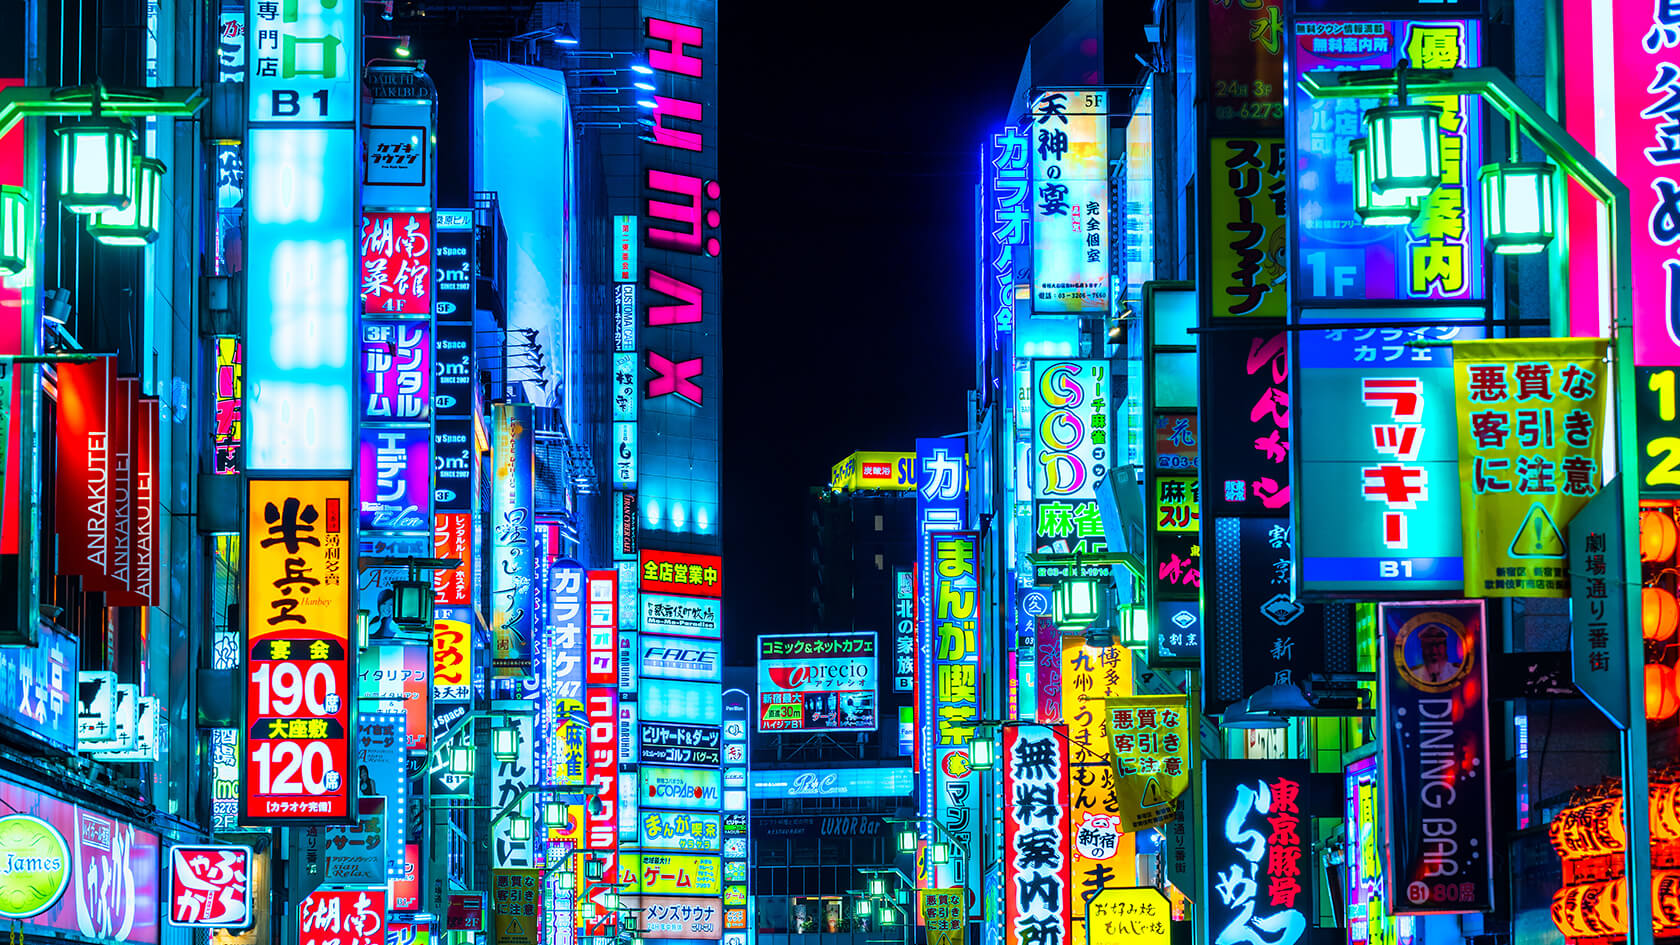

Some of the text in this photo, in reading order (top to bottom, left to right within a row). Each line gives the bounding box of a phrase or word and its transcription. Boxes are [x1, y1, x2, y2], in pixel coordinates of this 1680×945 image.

[271, 89, 329, 117] B1
[1085, 94, 1102, 108] 5F
[371, 154, 421, 165] ラウンジ
[1037, 92, 1071, 217] 天神の宴
[1086, 201, 1101, 264] 完全個室
[1306, 251, 1357, 297] 1F
[382, 297, 407, 313] 4F
[367, 326, 391, 342] 3F
[1354, 345, 1433, 362] カフェ
[367, 348, 393, 417] ルーム
[397, 324, 423, 418] レンタル
[1467, 363, 1596, 403] 悪質な
[1090, 366, 1107, 446] リーチ麻雀
[1038, 361, 1087, 496] GOD
[1469, 408, 1595, 450] 客引き
[376, 433, 407, 503] エデン
[1361, 376, 1428, 550] ラッキー
[1473, 455, 1597, 497] に注意
[87, 430, 107, 567] ANRAKUTEI
[111, 452, 130, 584] ANRAKUTEI
[1036, 501, 1106, 538] 麻雀
[134, 471, 152, 599] ANRAKUTEI
[643, 559, 718, 587] 全店営業中
[1379, 560, 1413, 578] B1
[455, 571, 465, 600] ホステル
[1585, 531, 1611, 673] 劇場通り一番街
[553, 567, 581, 680] カラオケ
[896, 600, 913, 674] 北の家族
[644, 647, 719, 664] FACE
[762, 639, 873, 655] コミック&ネットカフェ
[937, 538, 977, 746] まんが喫茶
[359, 669, 426, 682] イタリアン
[620, 650, 630, 687] MARUHAN
[268, 718, 329, 739] 大座敷
[1112, 708, 1180, 730] 悪質な
[620, 721, 630, 759] MARUHAN
[642, 726, 720, 748] ビリヤード&ダーツ
[1113, 733, 1181, 754] 客引き
[666, 749, 691, 762] ゴルフ
[1117, 757, 1183, 778] に注意
[446, 775, 460, 783] B1
[1419, 699, 1459, 878] DINING BAR
[214, 815, 234, 828] 2F
[645, 812, 717, 839] まんが喫茶
[820, 815, 881, 836] LUXOR Bar
[1014, 737, 1061, 945] 無料案内所
[1078, 828, 1116, 849] 新宿
[1267, 776, 1302, 908] 東京豚骨
[3, 852, 63, 874] James
[1091, 849, 1106, 858] の
[644, 865, 693, 889] ゲーム
[647, 904, 715, 922] メンズサウナ
[926, 894, 960, 905] 悪質な
[926, 907, 960, 918] 客引き
[926, 919, 961, 930] に注意
